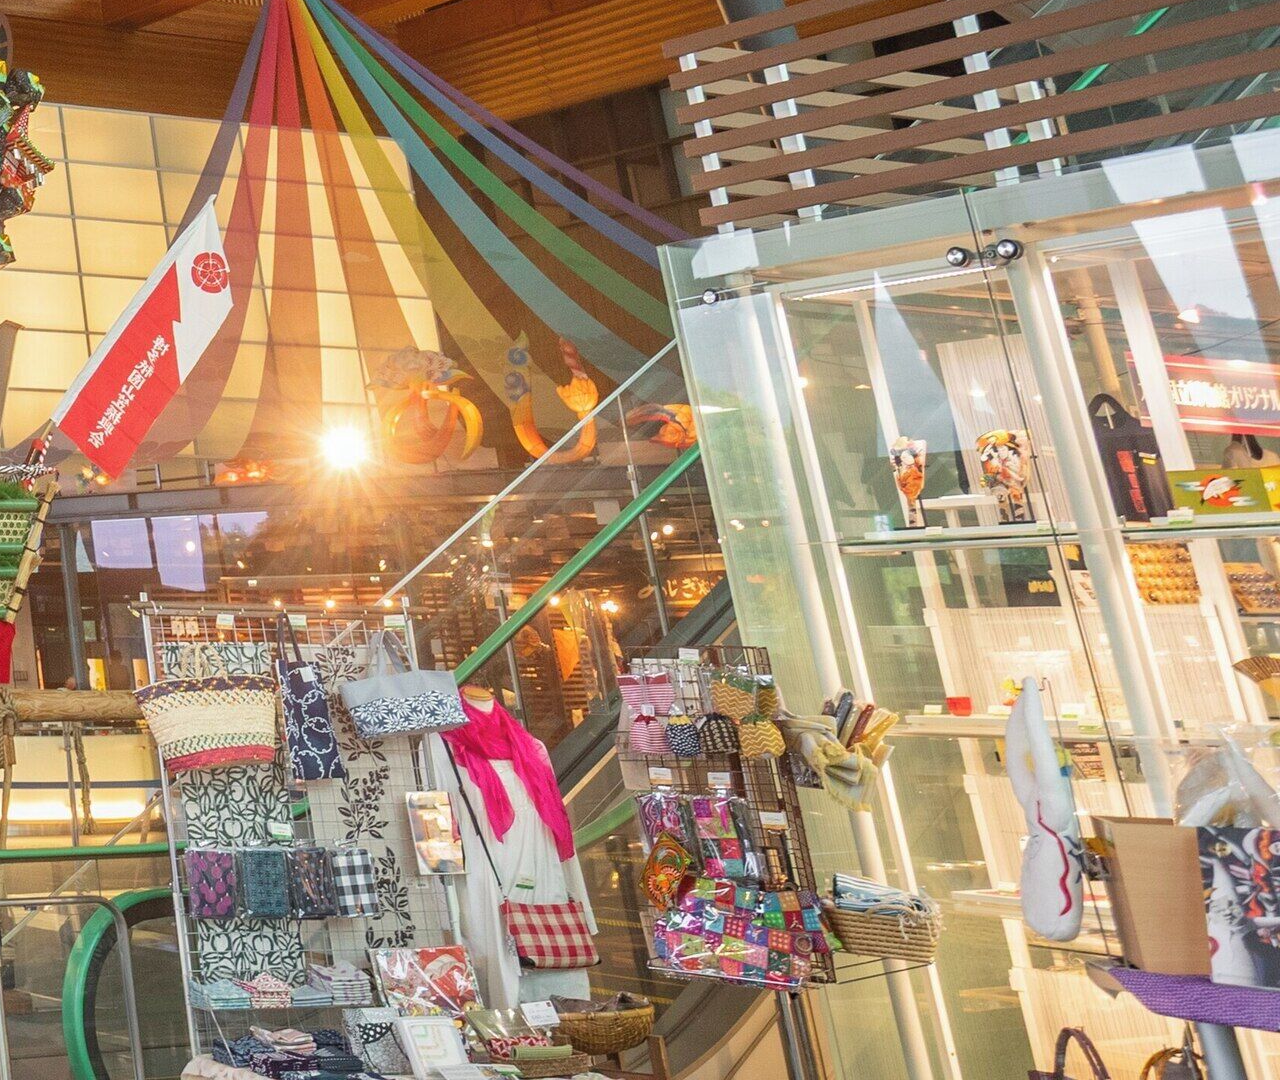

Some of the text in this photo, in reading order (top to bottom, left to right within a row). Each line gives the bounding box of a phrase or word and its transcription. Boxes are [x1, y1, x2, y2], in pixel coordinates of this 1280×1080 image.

[87, 334, 170, 449] 博多祇園山笠振興会
